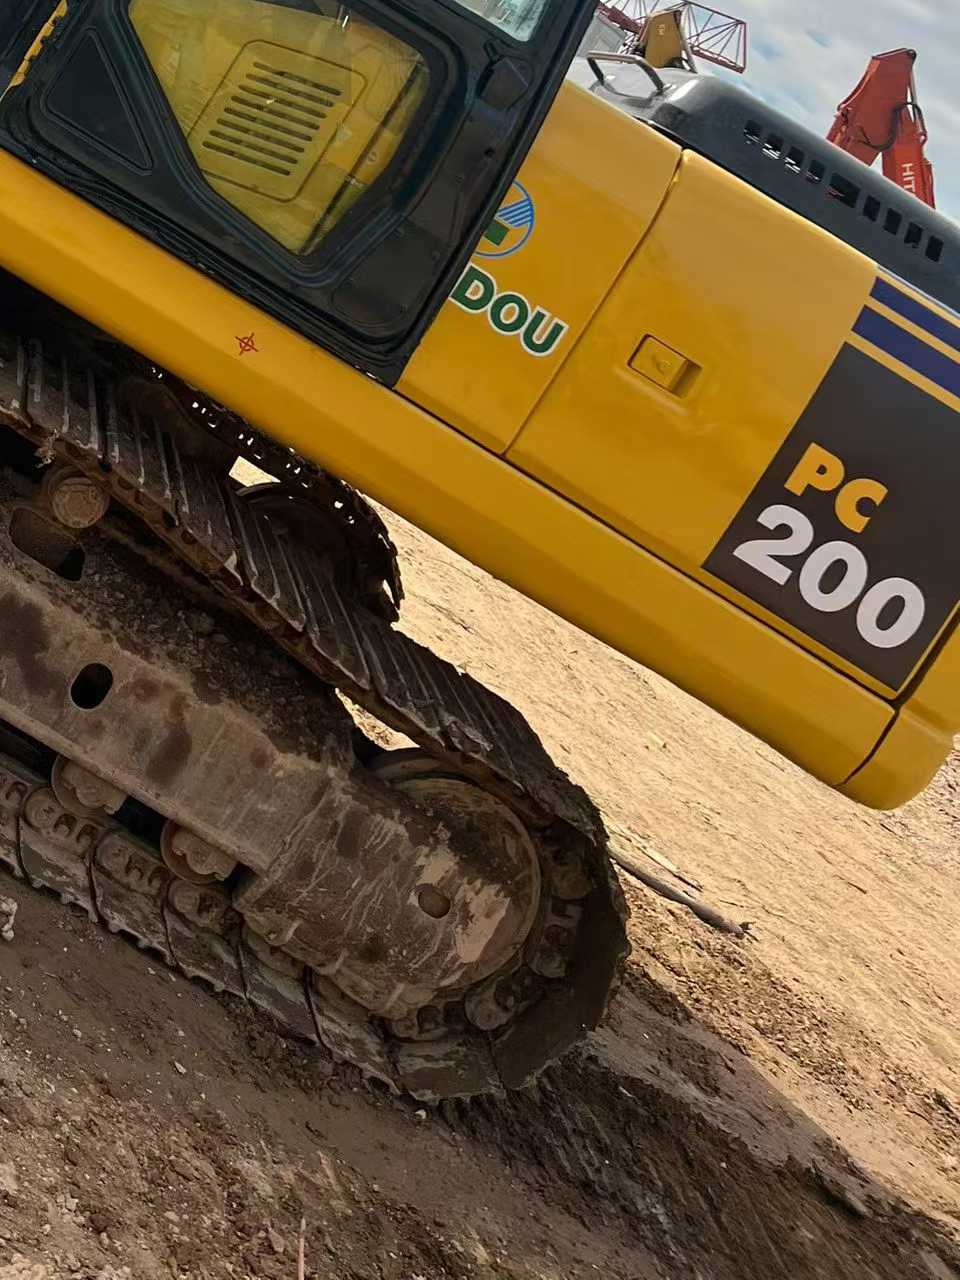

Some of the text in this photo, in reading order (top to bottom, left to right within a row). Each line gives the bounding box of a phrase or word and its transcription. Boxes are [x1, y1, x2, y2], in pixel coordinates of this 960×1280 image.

[448, 261, 569, 357] DOU
[784, 442, 888, 533] PC
[733, 504, 925, 648] 200
